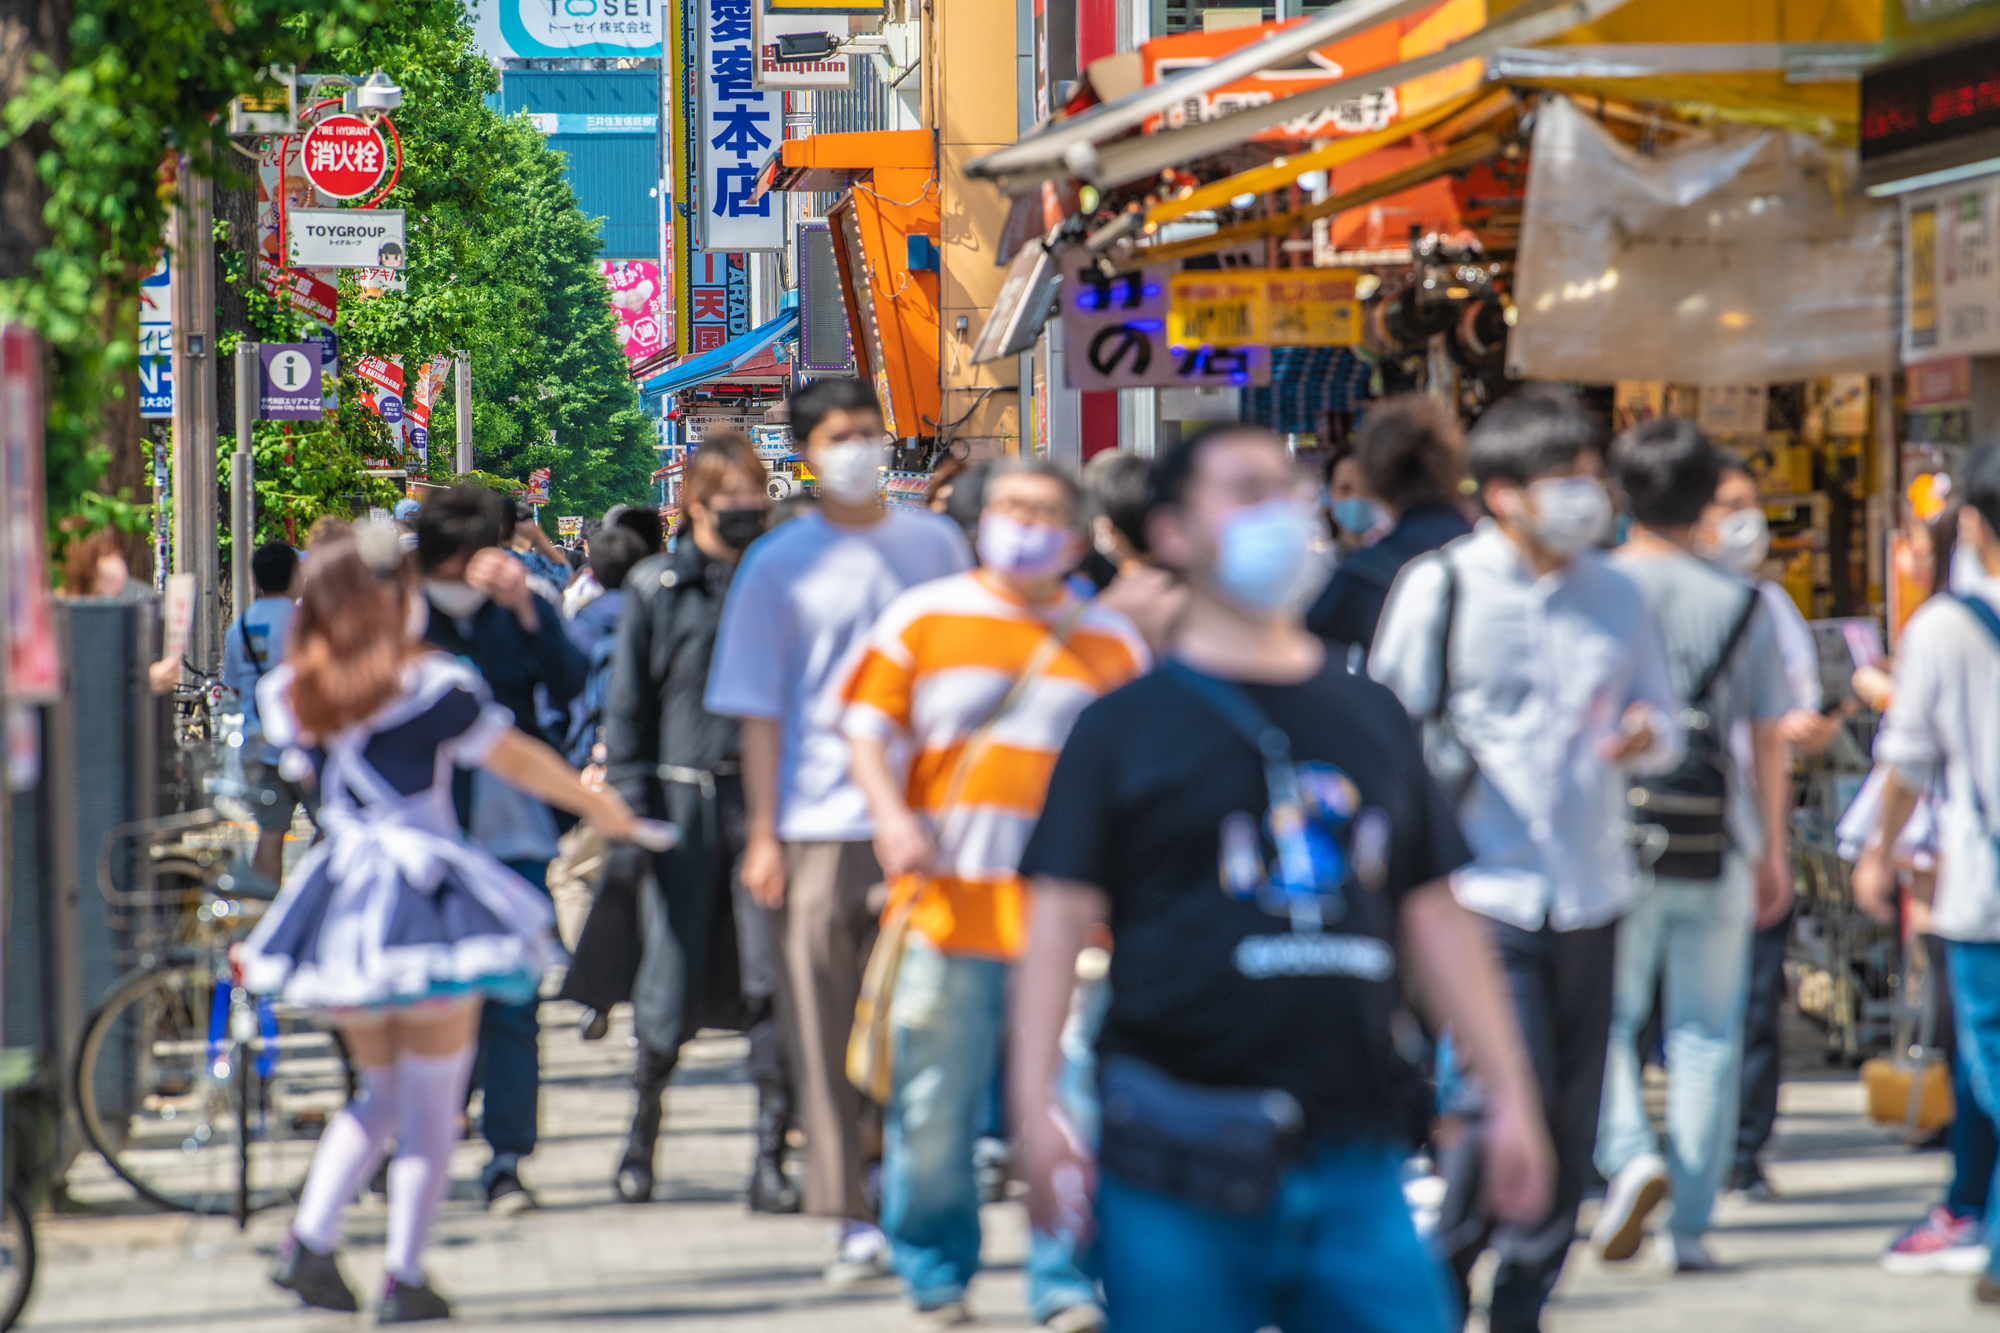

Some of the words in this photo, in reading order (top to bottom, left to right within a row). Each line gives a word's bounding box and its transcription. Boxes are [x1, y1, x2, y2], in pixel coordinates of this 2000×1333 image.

[547, 0, 652, 16] TOSEI
[548, 21, 652, 34] トーセイ株式会社
[316, 126, 334, 136] FIRE
[335, 125, 371, 136] HYDRANT
[310, 140, 380, 172] 消火栓
[306, 225, 386, 237] TOYGROUP
[366, 367, 401, 391] AKIHABARA
